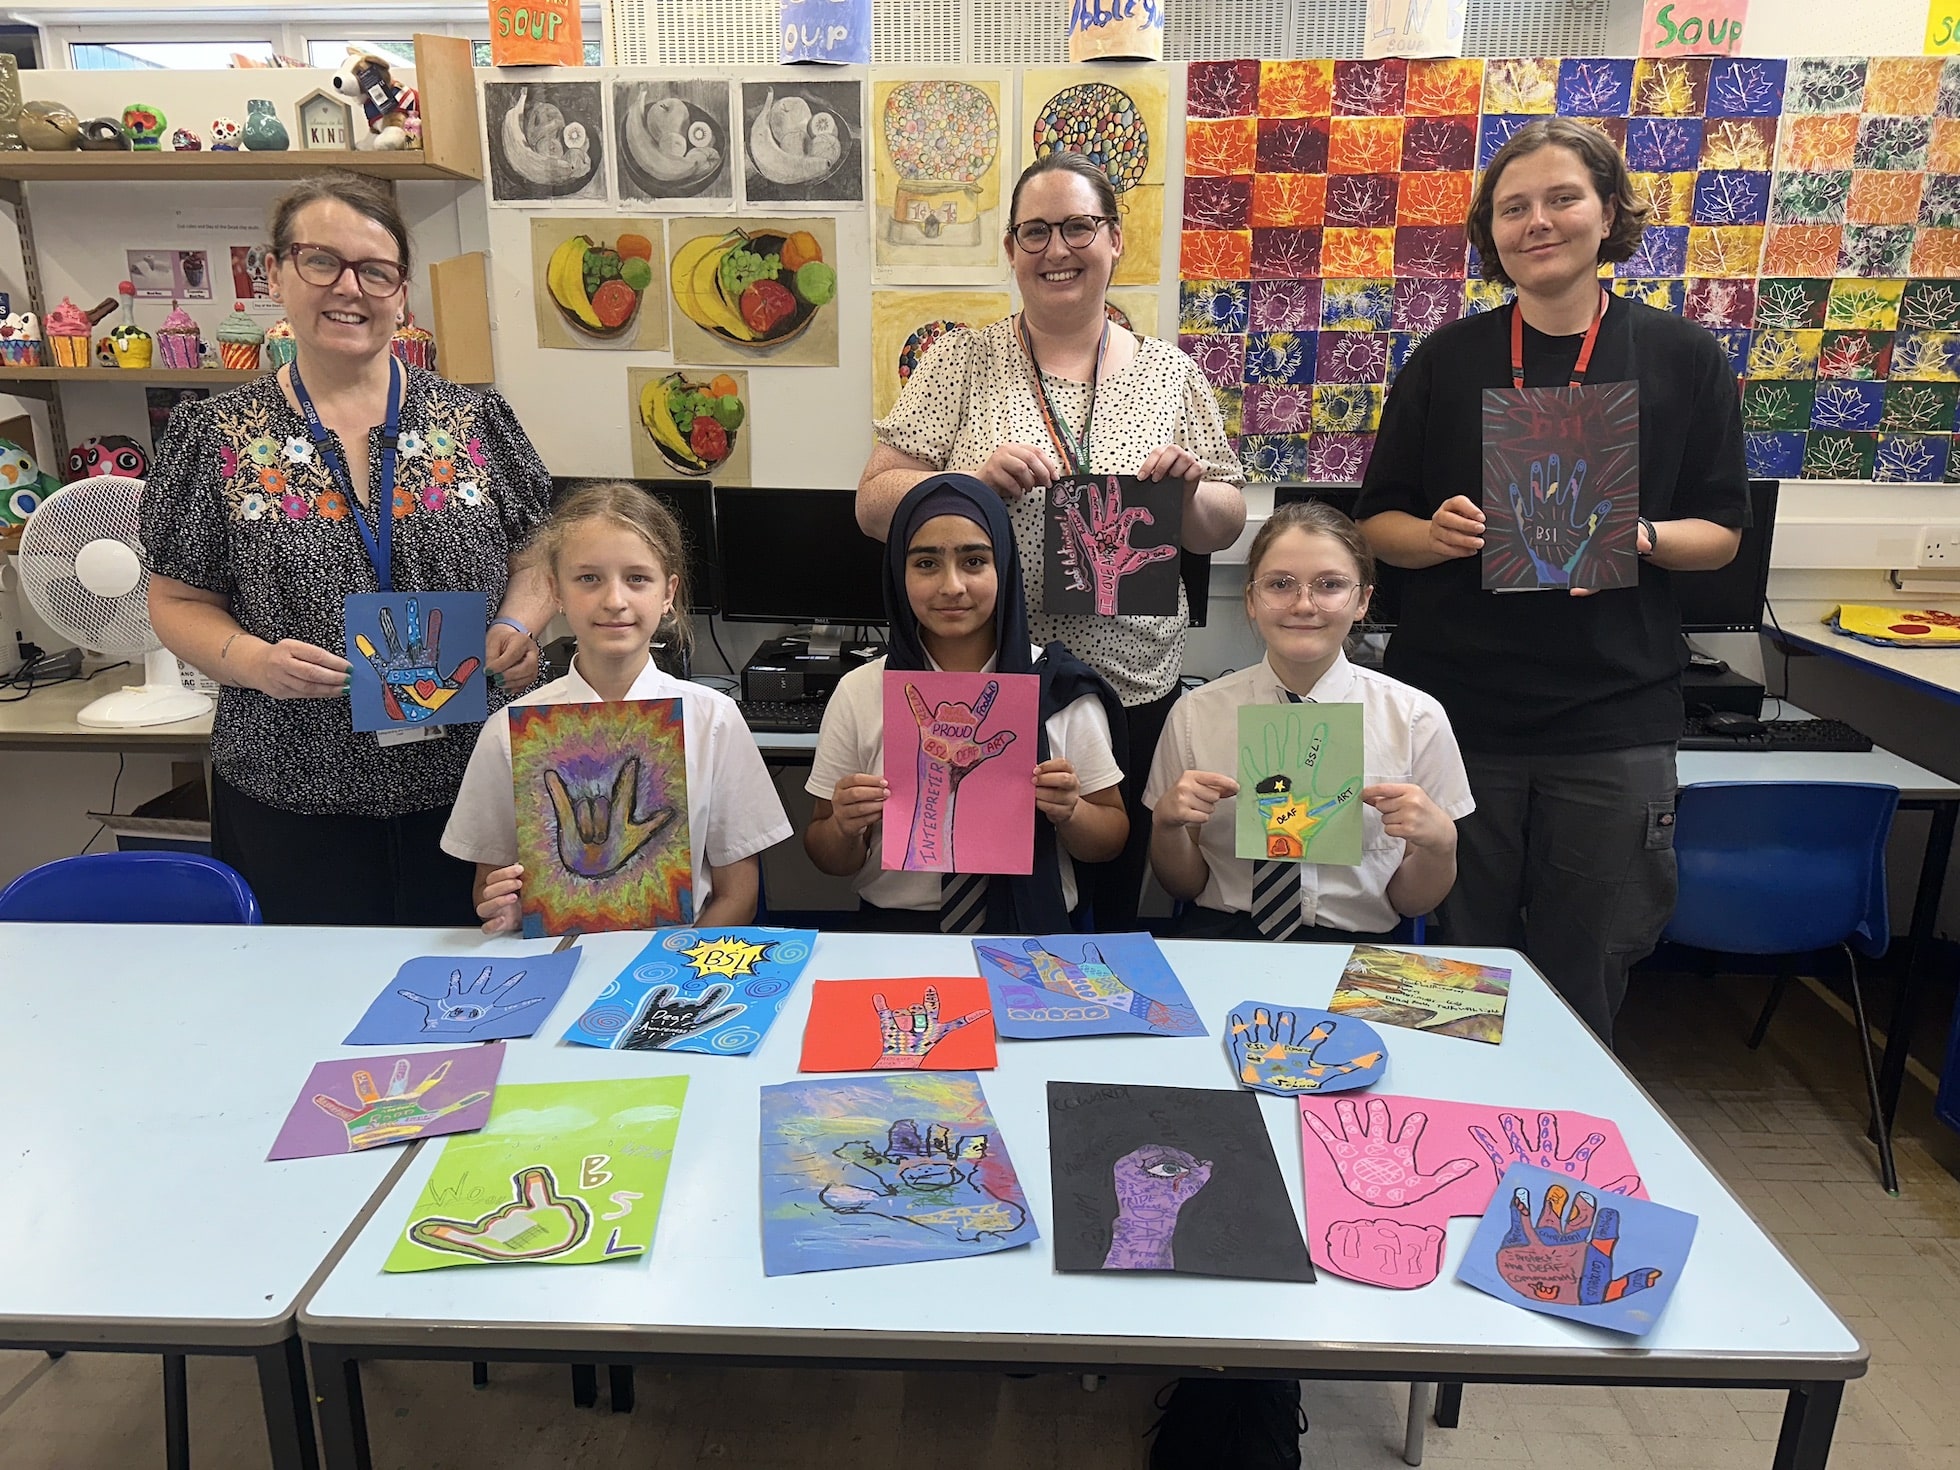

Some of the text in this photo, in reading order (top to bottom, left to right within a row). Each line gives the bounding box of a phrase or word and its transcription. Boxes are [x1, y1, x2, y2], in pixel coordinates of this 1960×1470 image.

[497, 6, 563, 41] SOUP
[311, 127, 345, 143] KIND
[302, 400, 318, 425] RSDD
[1075, 447, 1085, 466] RSDD
[1101, 568, 1116, 595] LOVE
[1100, 599, 1114, 614] I
[391, 670, 425, 681] BSL
[932, 723, 973, 738] PROUD
[924, 741, 946, 760] BSL
[987, 734, 1006, 753] ART
[955, 745, 979, 763] DEAF
[1336, 787, 1354, 804] ART
[919, 762, 944, 864] INTERPRETER
[1276, 807, 1297, 825] DEAF
[1120, 1195, 1155, 1208] PRIDE
[1504, 1261, 1568, 1273] the DEAF
